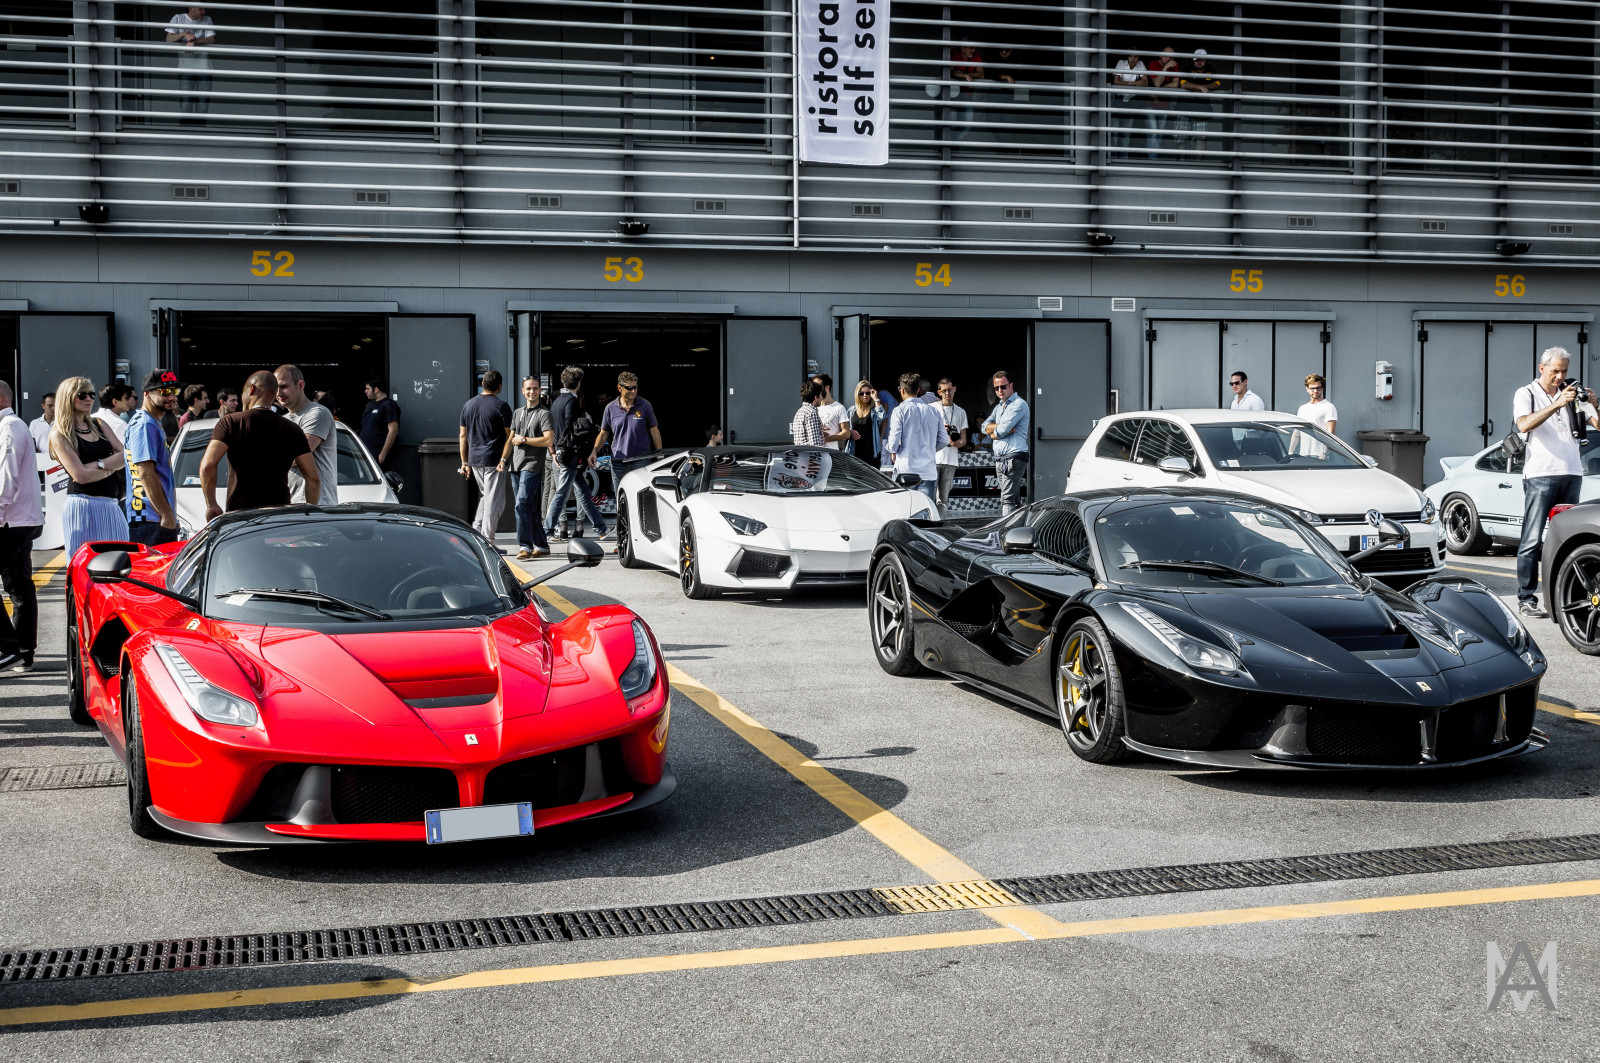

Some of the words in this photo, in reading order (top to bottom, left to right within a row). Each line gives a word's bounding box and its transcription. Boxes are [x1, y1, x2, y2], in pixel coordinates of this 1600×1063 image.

[854, 0, 876, 50] se
[843, 65, 875, 136] self
[250, 250, 295, 277] 52
[603, 256, 644, 283] 53
[914, 262, 953, 287] 54
[1229, 269, 1264, 293] 55
[1494, 274, 1526, 298] 56
